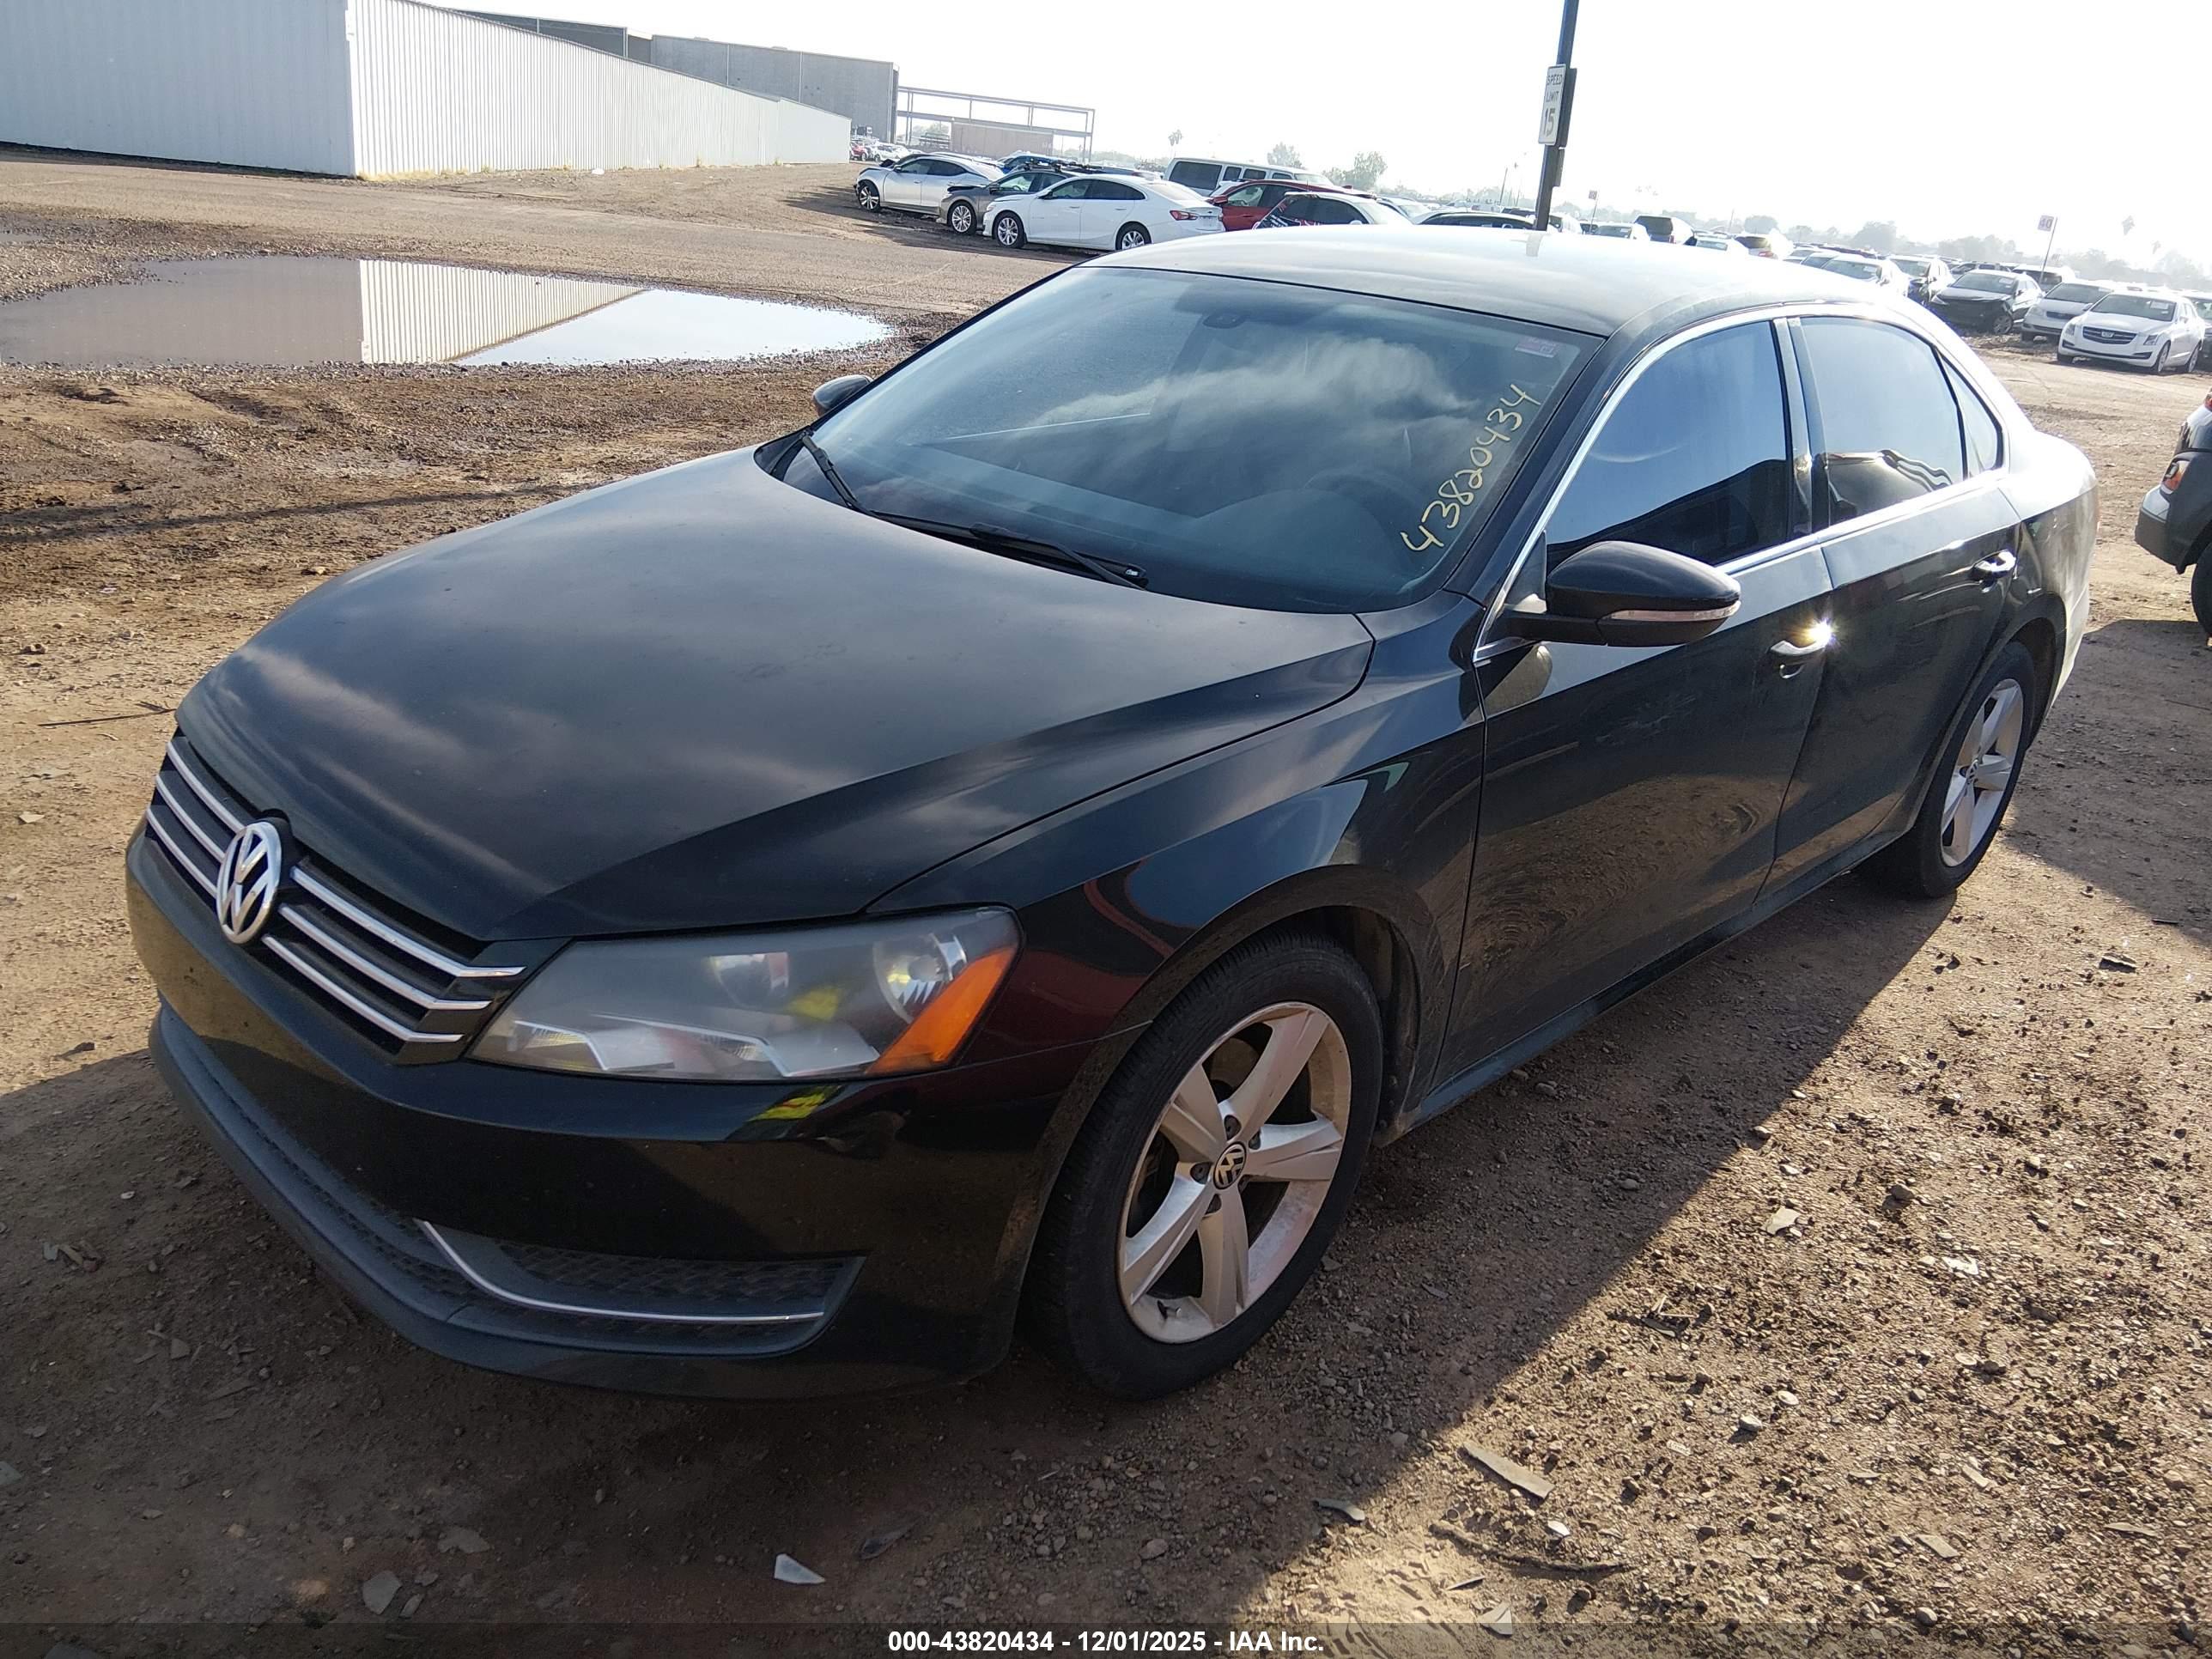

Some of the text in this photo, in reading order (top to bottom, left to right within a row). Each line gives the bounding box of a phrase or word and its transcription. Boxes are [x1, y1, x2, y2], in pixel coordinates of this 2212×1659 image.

[1547, 74, 1563, 85] SPEED
[1546, 91, 1559, 102] LIMIT
[1543, 107, 1556, 137] 15
[1401, 384, 1541, 552] 43820434
